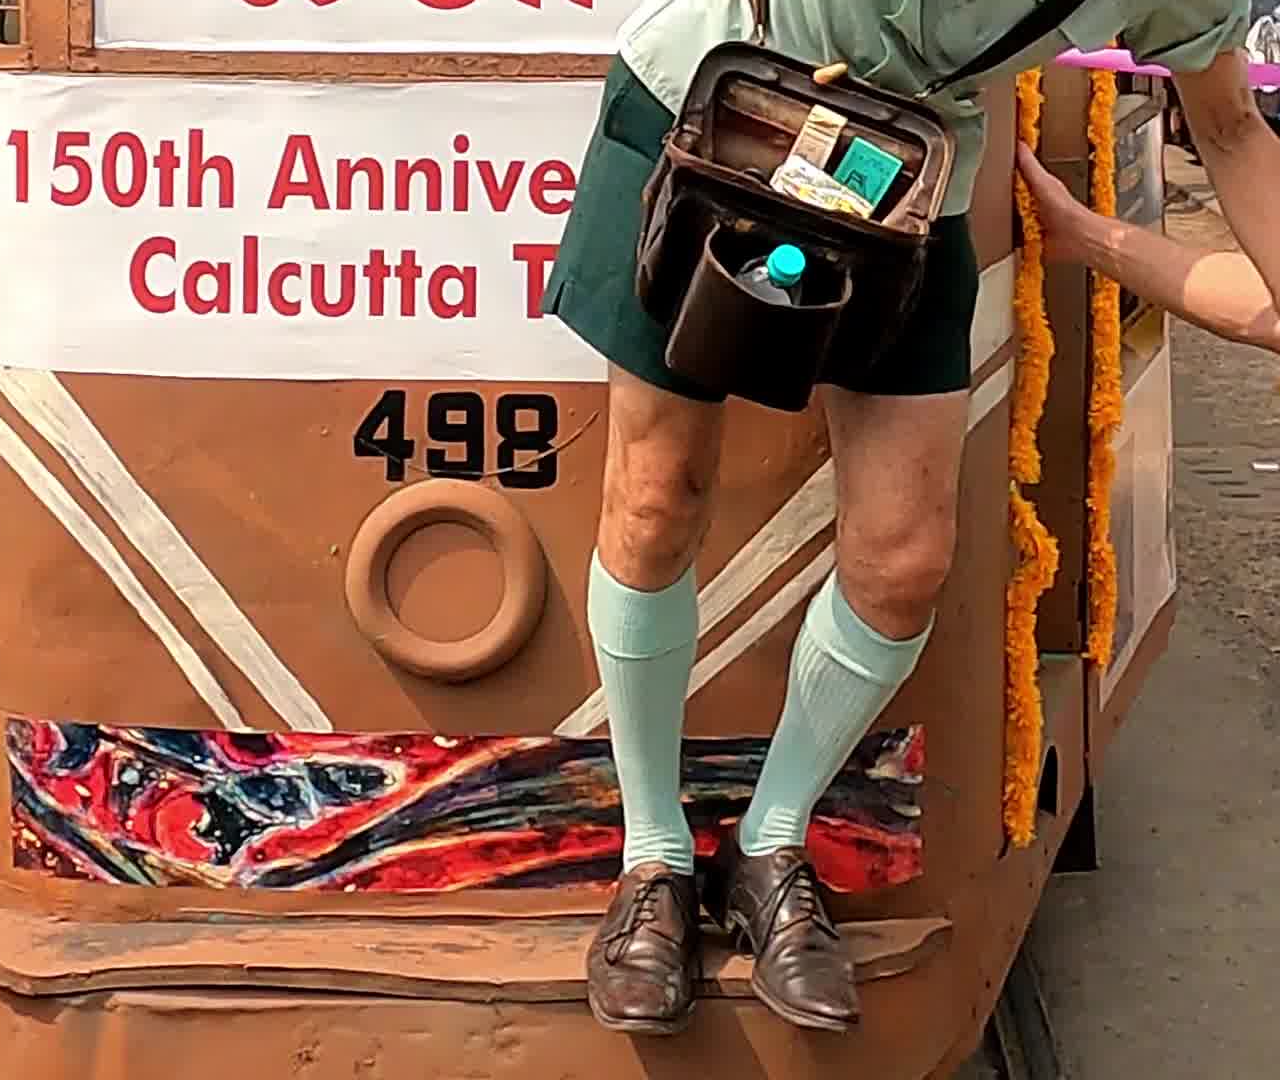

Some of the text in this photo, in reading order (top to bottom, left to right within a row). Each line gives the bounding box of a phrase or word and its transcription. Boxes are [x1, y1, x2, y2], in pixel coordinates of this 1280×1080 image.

[7, 128, 578, 215] 150th Annive
[129, 235, 478, 319] Calcutta
[352, 389, 559, 490] 498
